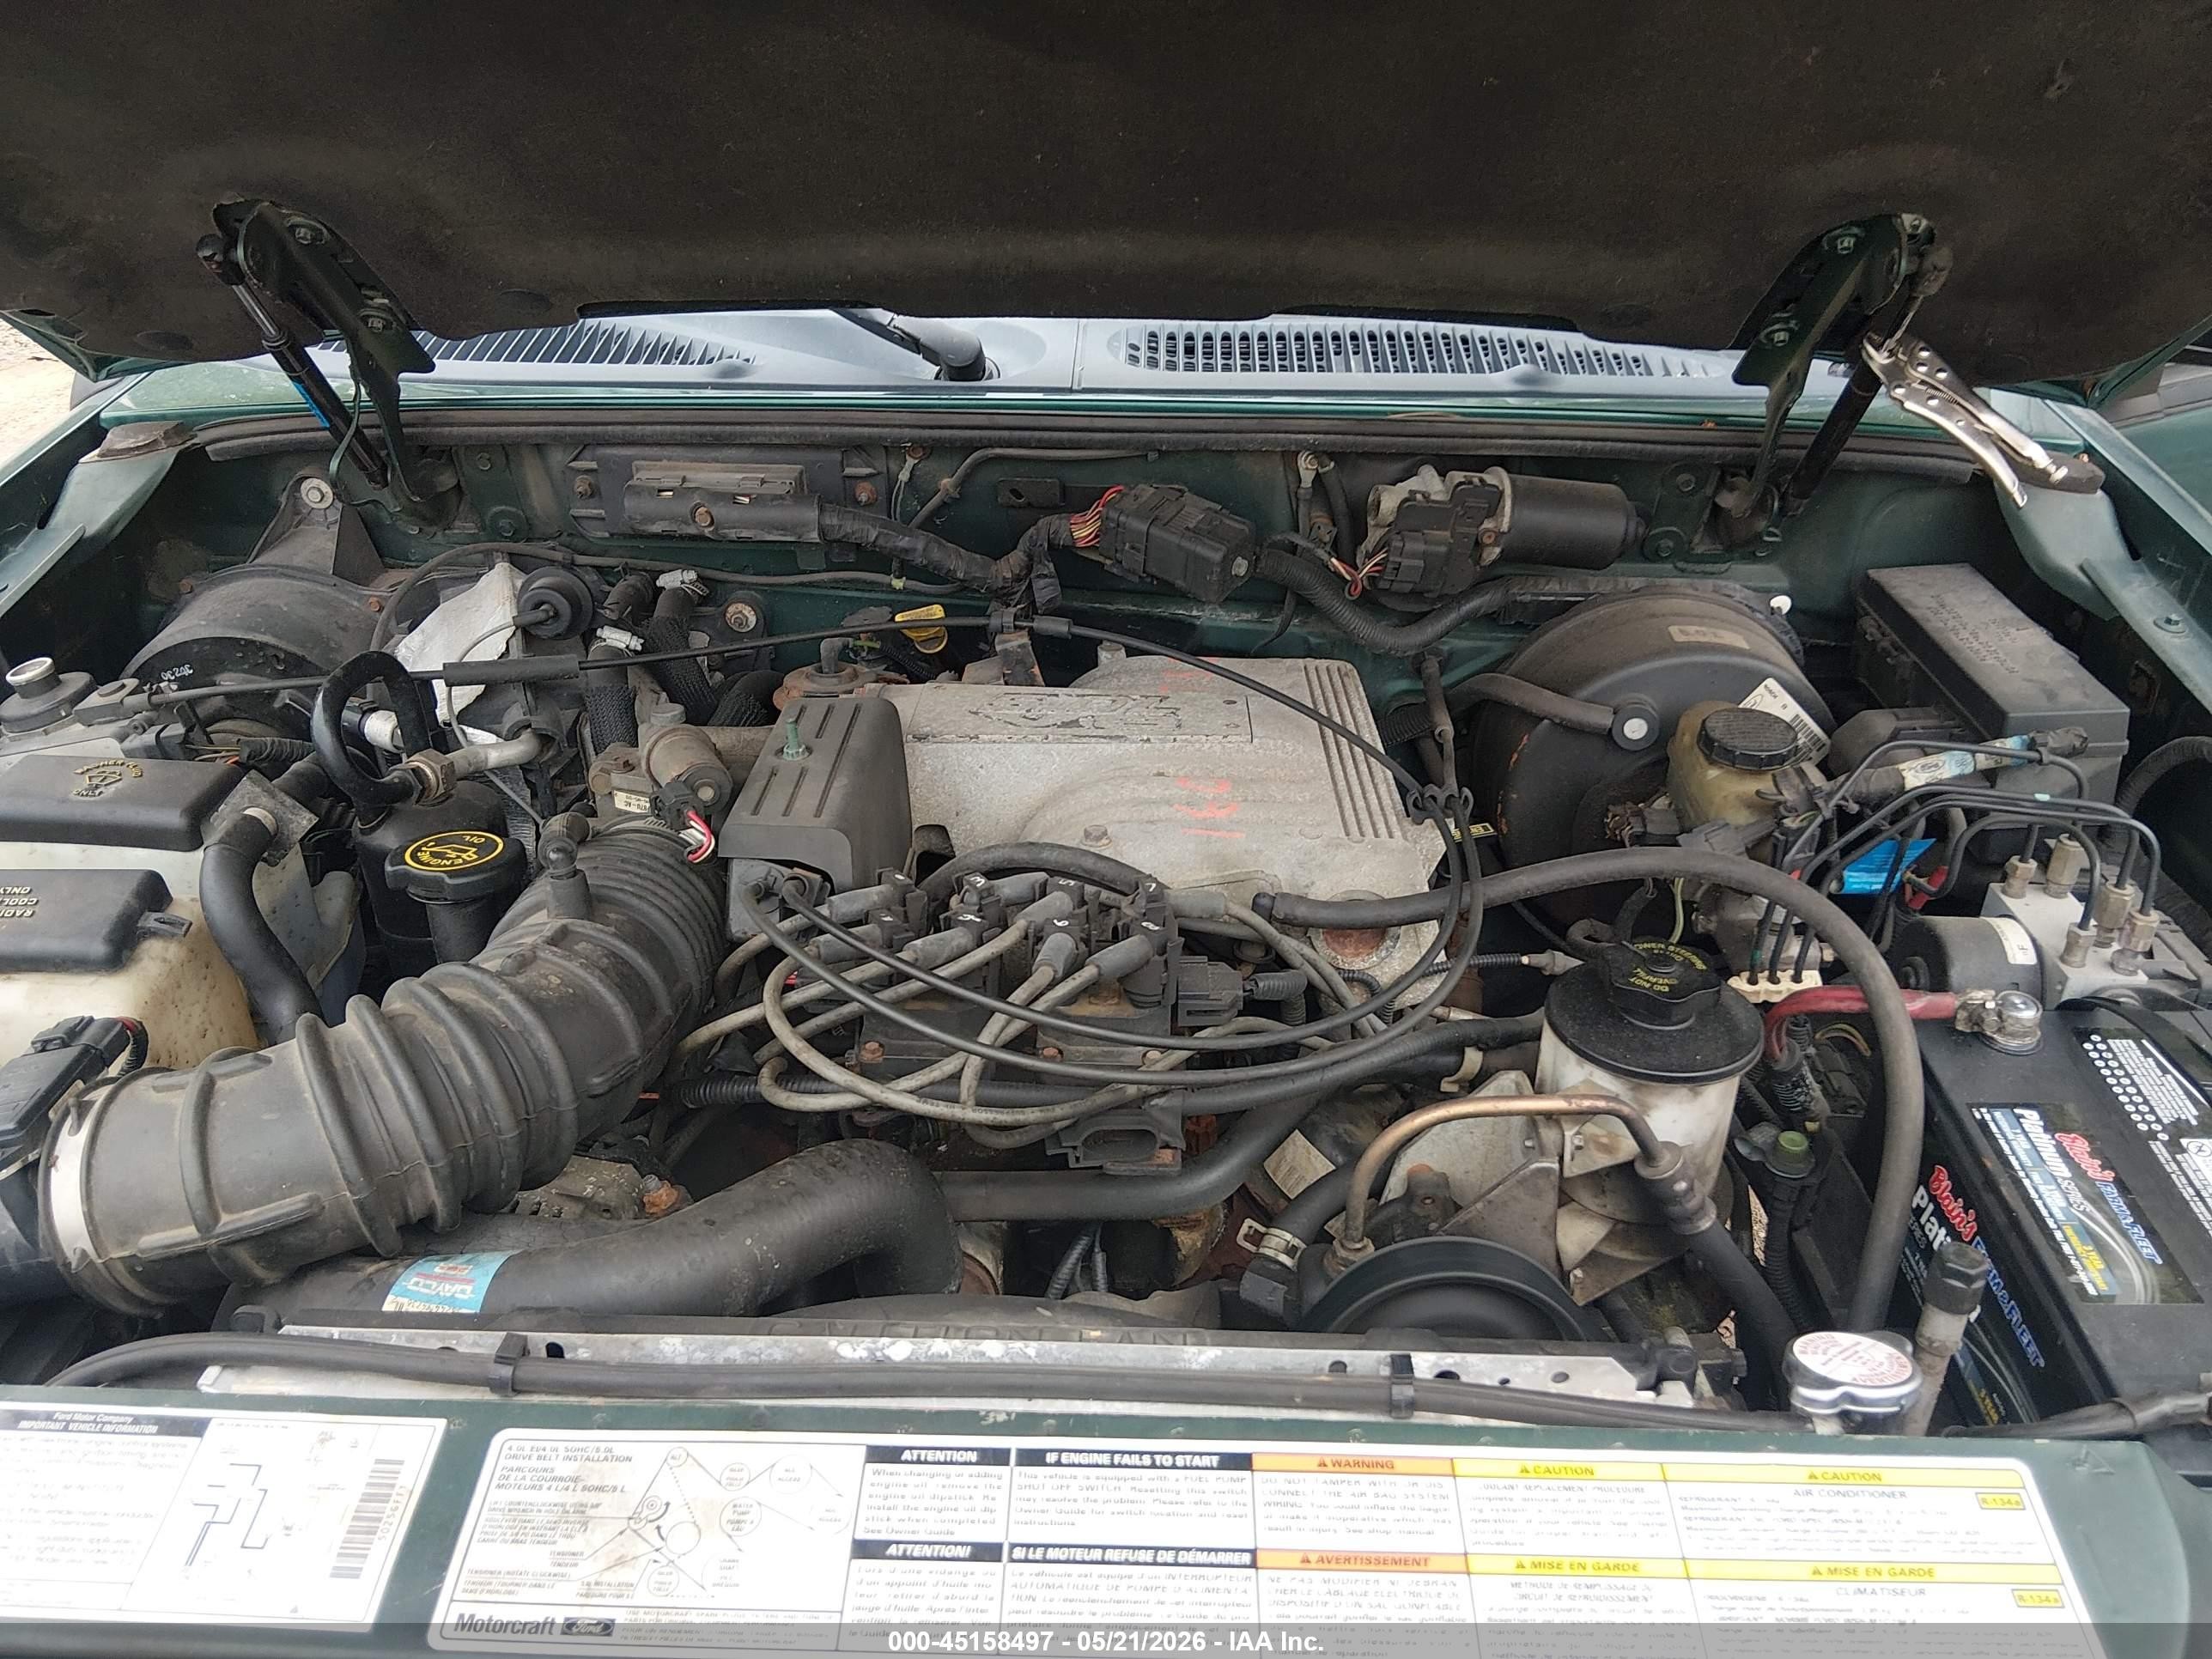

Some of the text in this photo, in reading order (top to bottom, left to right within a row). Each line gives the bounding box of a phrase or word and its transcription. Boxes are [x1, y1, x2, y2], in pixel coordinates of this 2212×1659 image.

[417, 851, 463, 865] ENGINE
[0, 896, 38, 906] COOL
[2013, 1108, 2086, 1212] Platinum SERIES
[1929, 1165, 1977, 1242] Blain's
[2055, 1133, 2115, 1182] Blain's
[2128, 1222, 2163, 1265] FLEET
[53, 1411, 134, 1424] Ford Motor Company
[17, 1420, 158, 1433] IMPORTANT VEHICLE INFORMATION
[901, 1449, 977, 1462] ATTENTION
[1046, 1452, 1220, 1468] IF ENGINE FAILS TO START
[1330, 1458, 1395, 1469] WARNING
[1533, 1466, 1595, 1476] CAUTION
[1821, 1471, 1882, 1482] CAUTION
[1793, 1488, 1908, 1499] AIR CONDITIONER
[885, 1544, 971, 1559] ATTENTION!
[1012, 1547, 1252, 1565] SI LE MOTEUR REFUSE DE DÉMARRER
[1315, 1553, 1431, 1567] AVERTISSEMENT
[1530, 1560, 1641, 1572] MISE EN GARDE
[1827, 1567, 1936, 1578] MISE EN GARDE
[1836, 1587, 1927, 1597] CLIMATISEUR
[453, 1613, 557, 1635] Motorcraft
